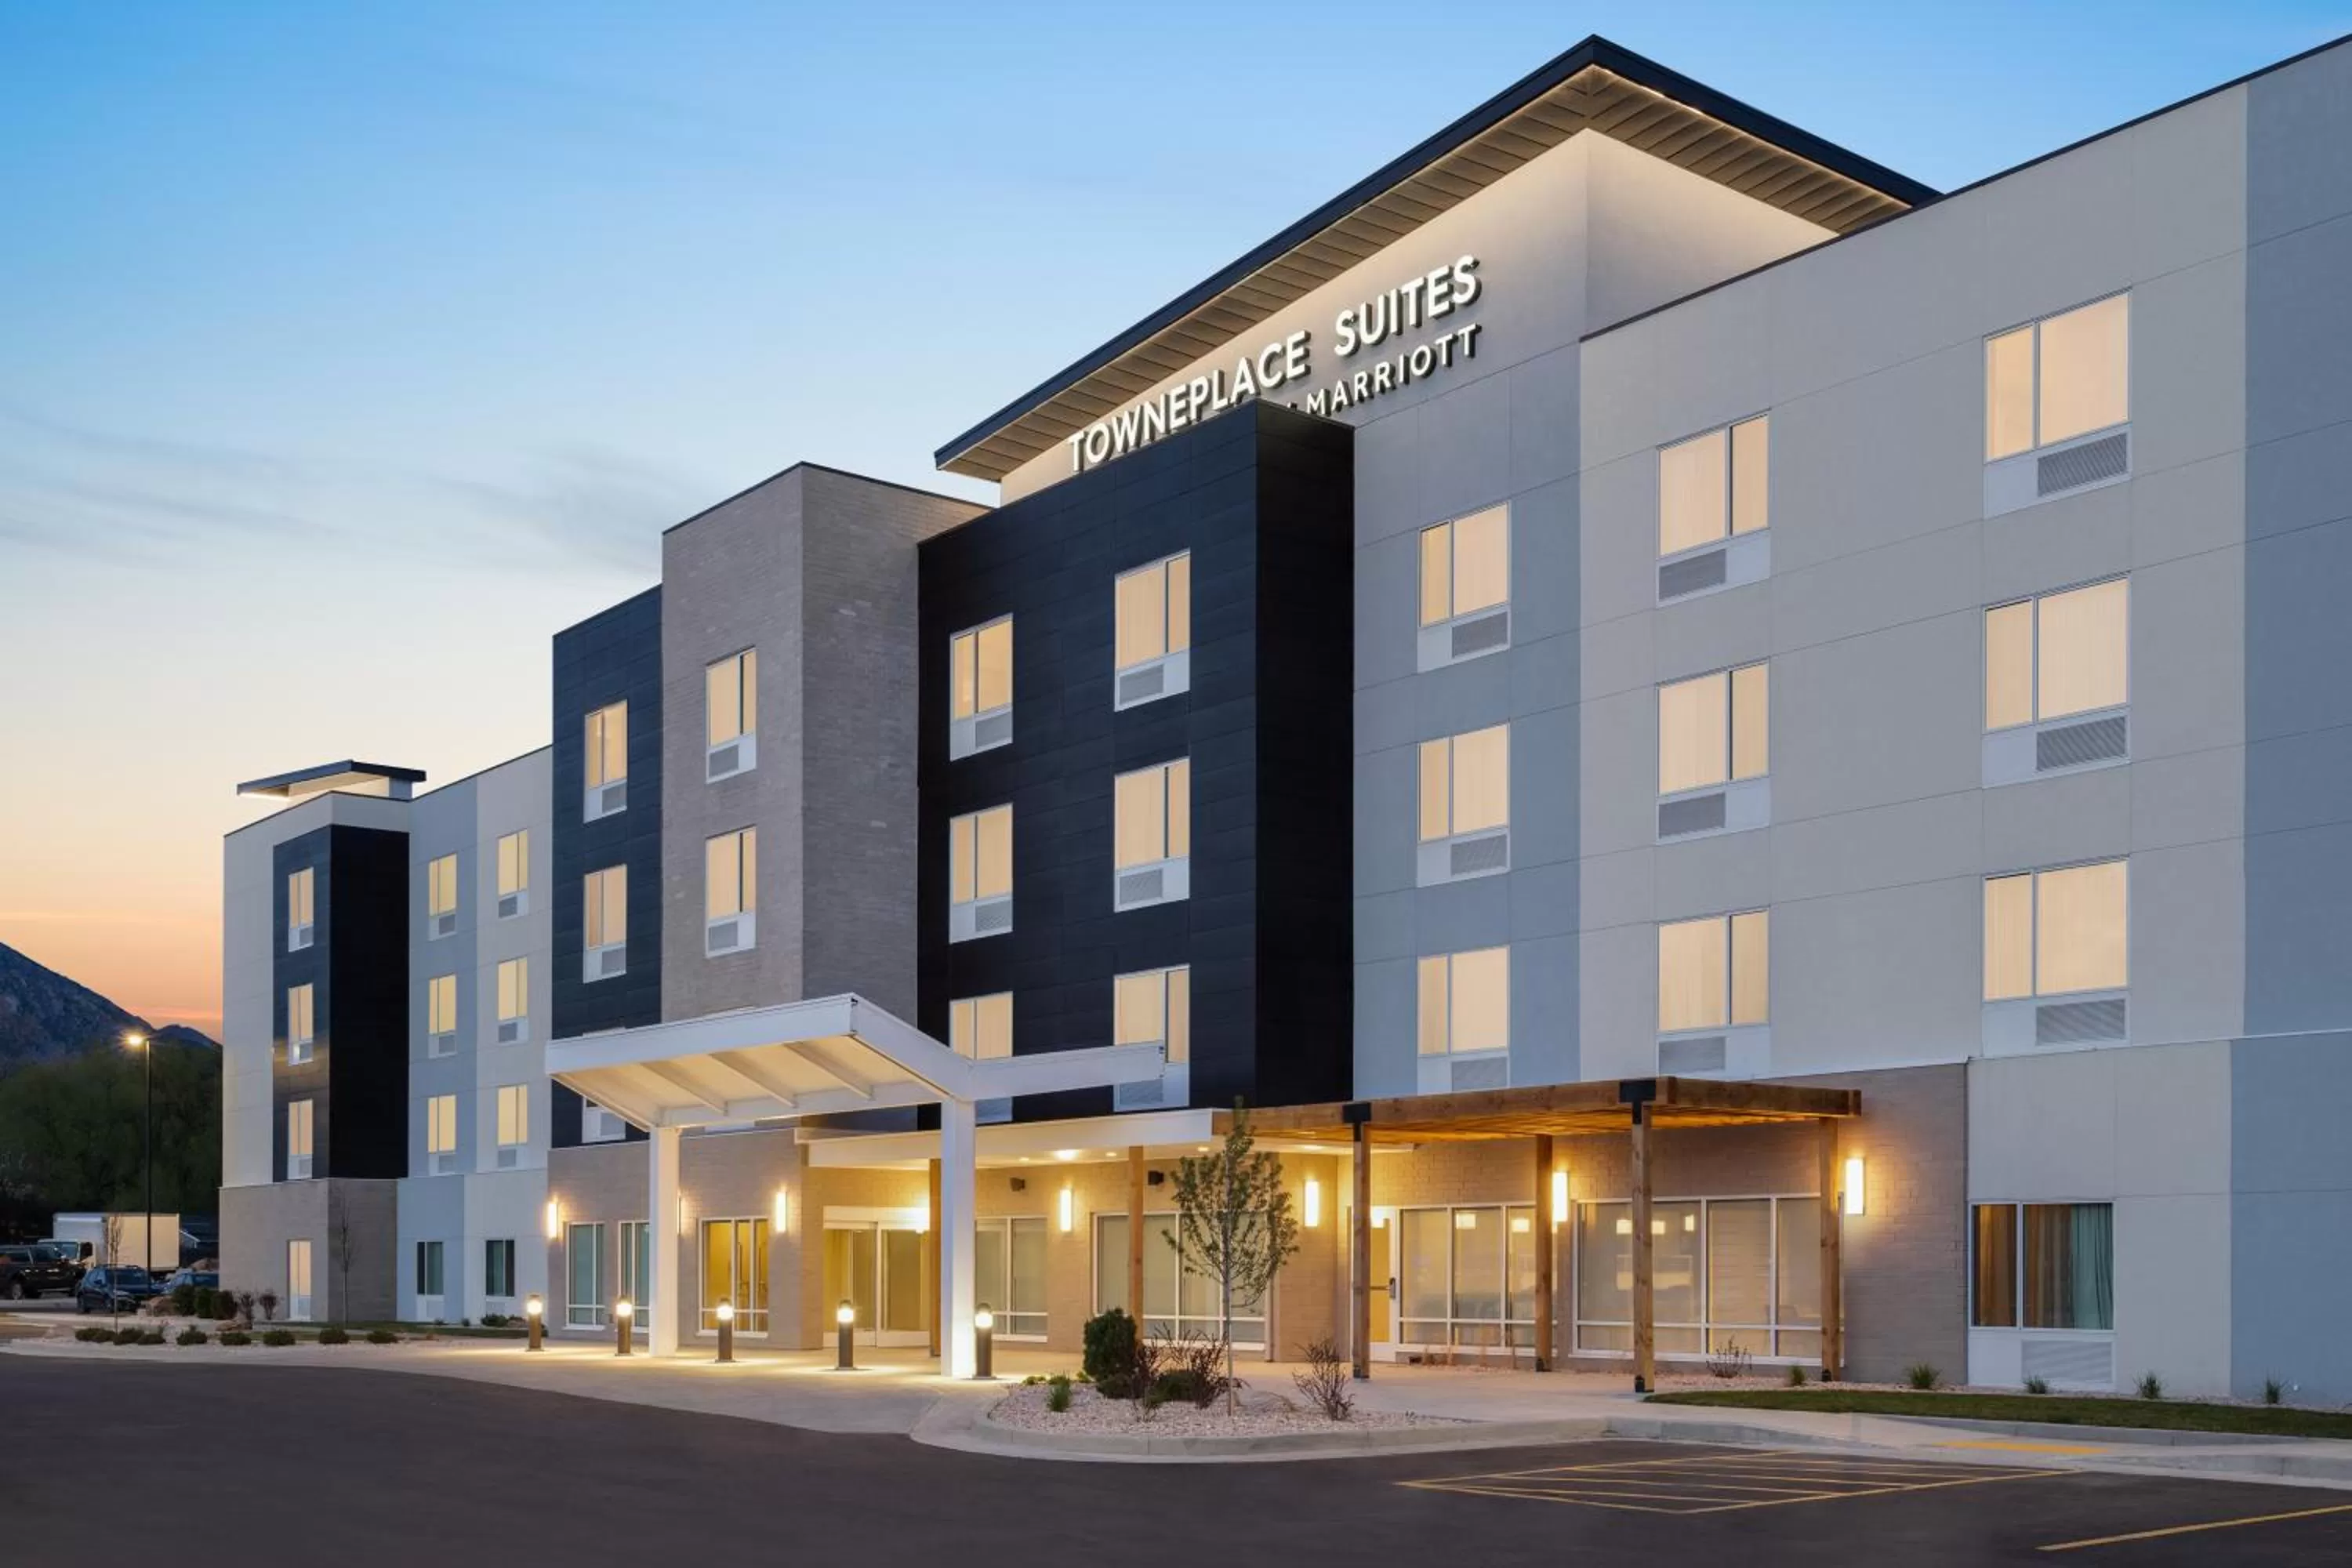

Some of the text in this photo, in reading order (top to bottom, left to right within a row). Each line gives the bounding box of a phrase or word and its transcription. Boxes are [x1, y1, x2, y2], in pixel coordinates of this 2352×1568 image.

[1069, 254, 1480, 472] TOWNEPLACE SUITES
[1306, 322, 1479, 416] MARRIOTT
